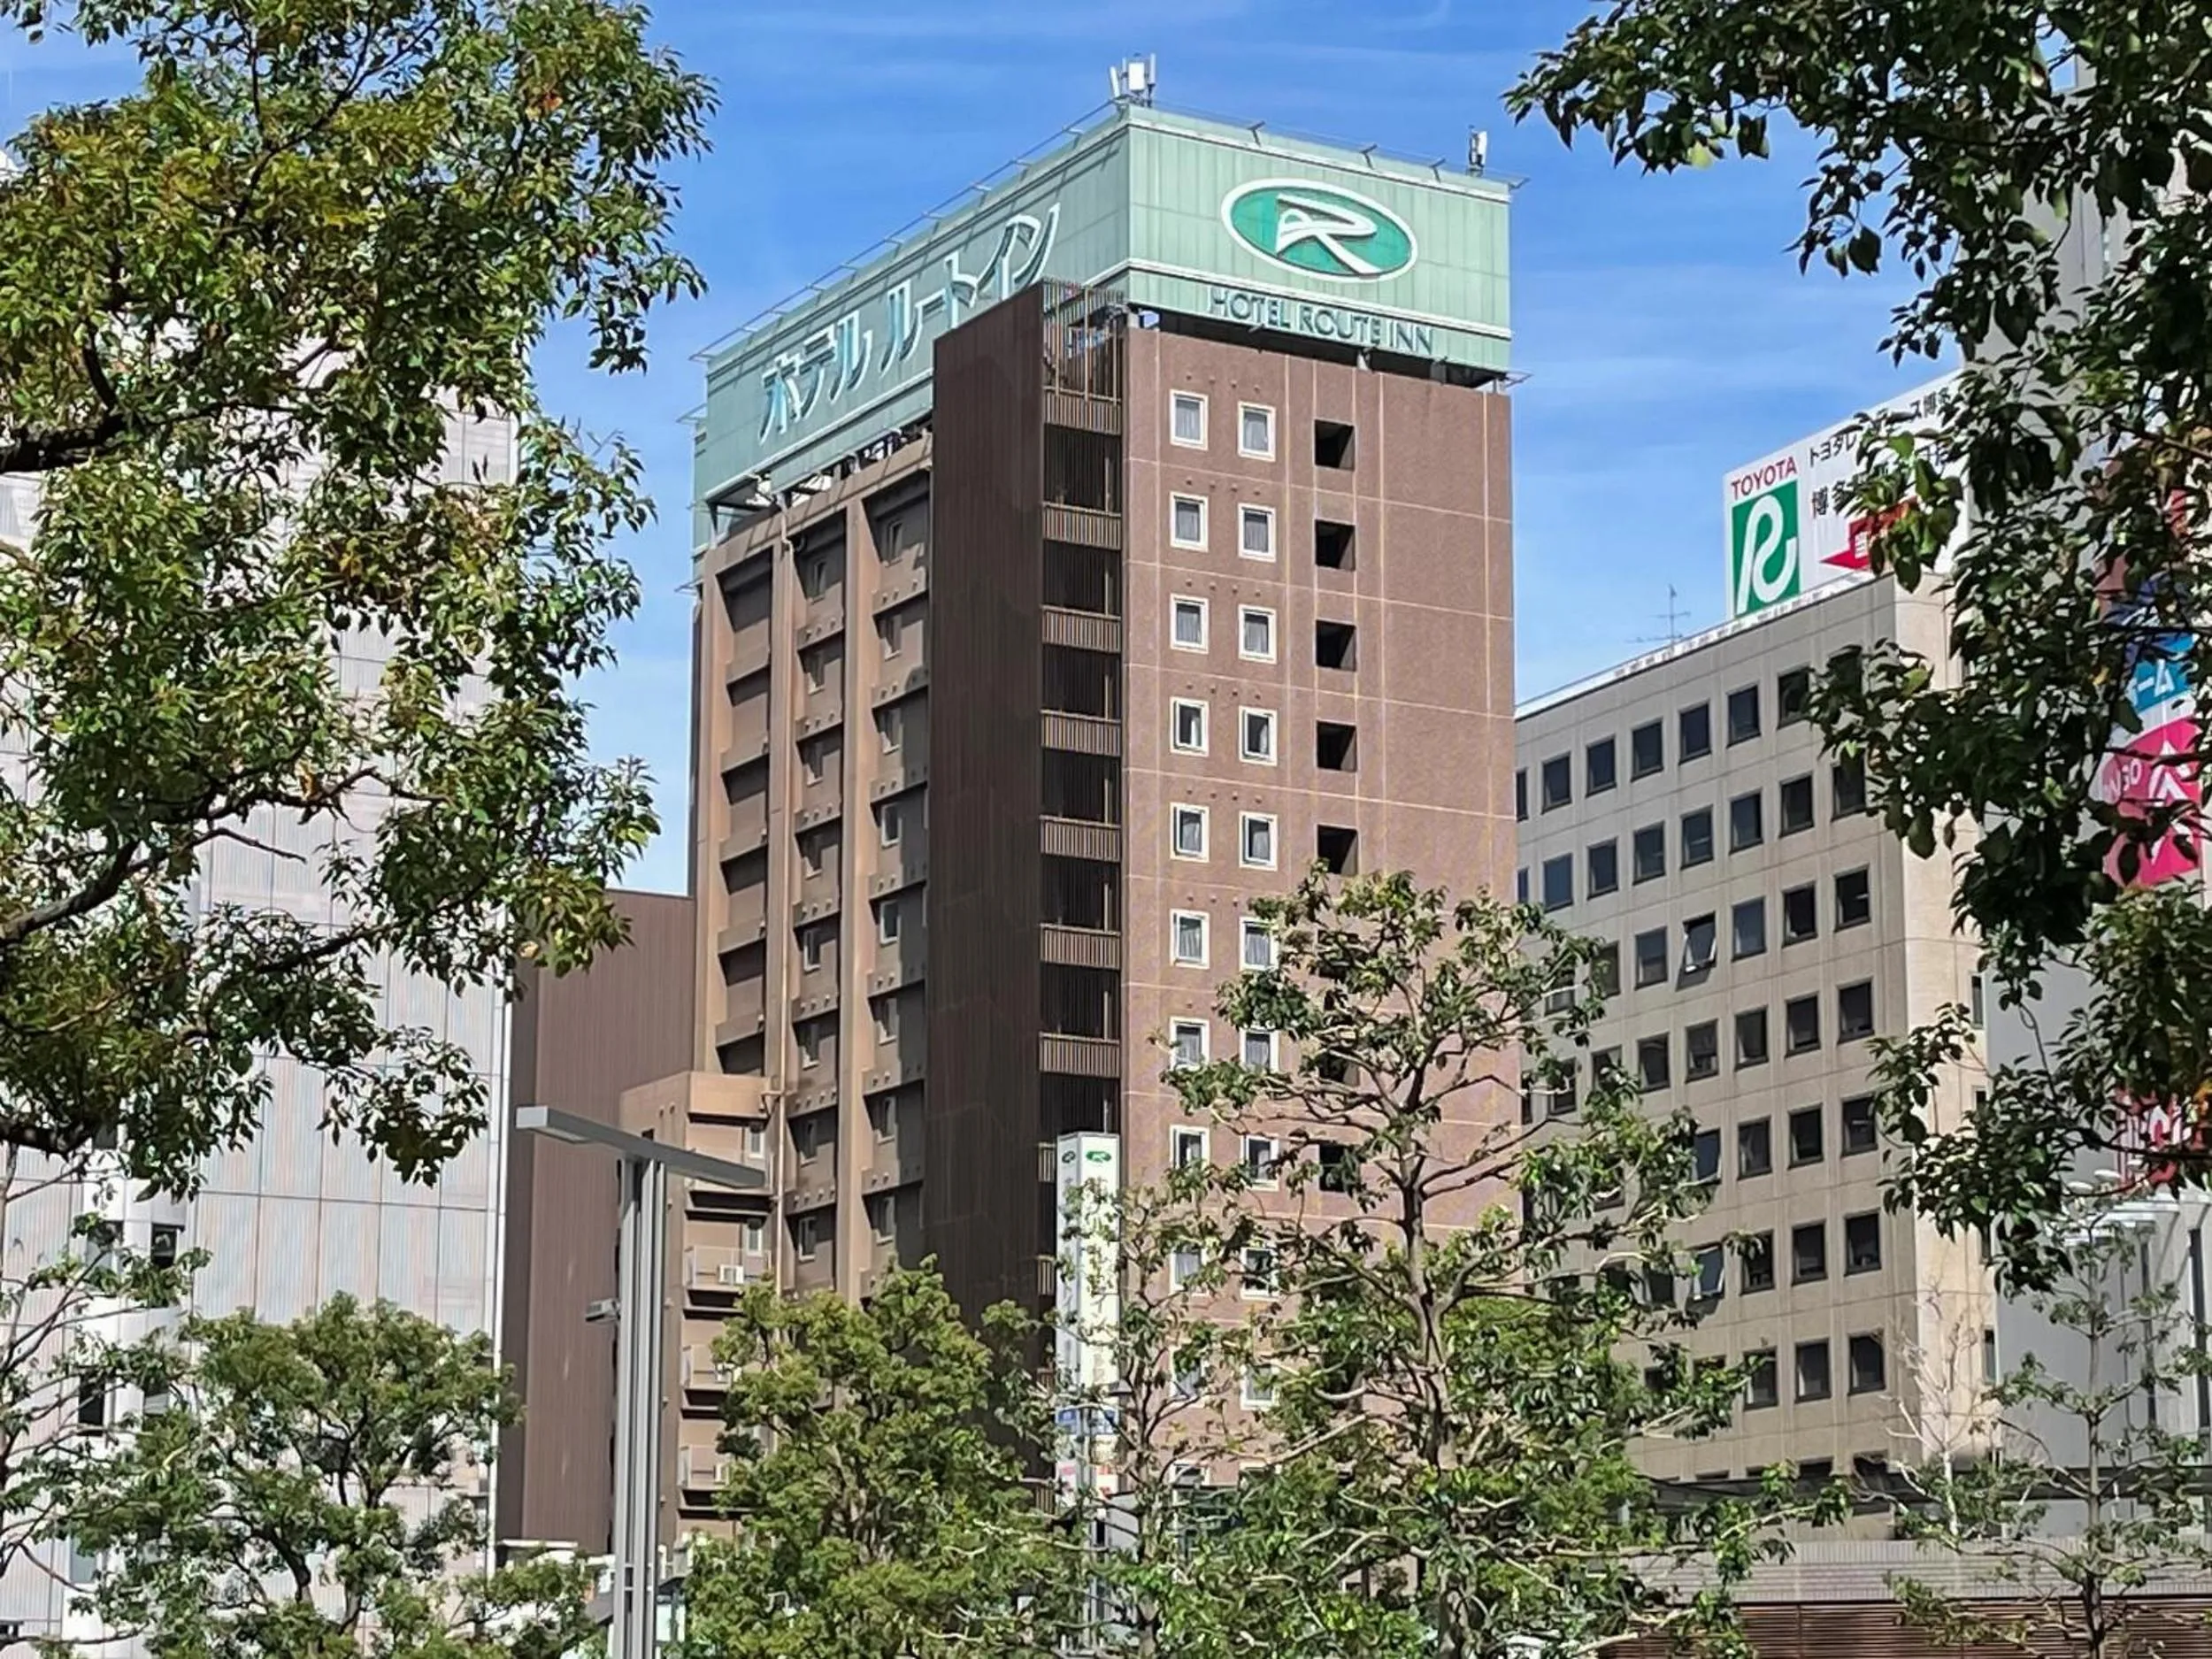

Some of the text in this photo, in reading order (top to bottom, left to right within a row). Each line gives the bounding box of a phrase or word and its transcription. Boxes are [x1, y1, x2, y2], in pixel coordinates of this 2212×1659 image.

[757, 202, 1061, 447] ホテル ルートイン
[1207, 286, 1434, 355] HOTEL ROUTE INN
[1731, 456, 1797, 501] TOYOTA
